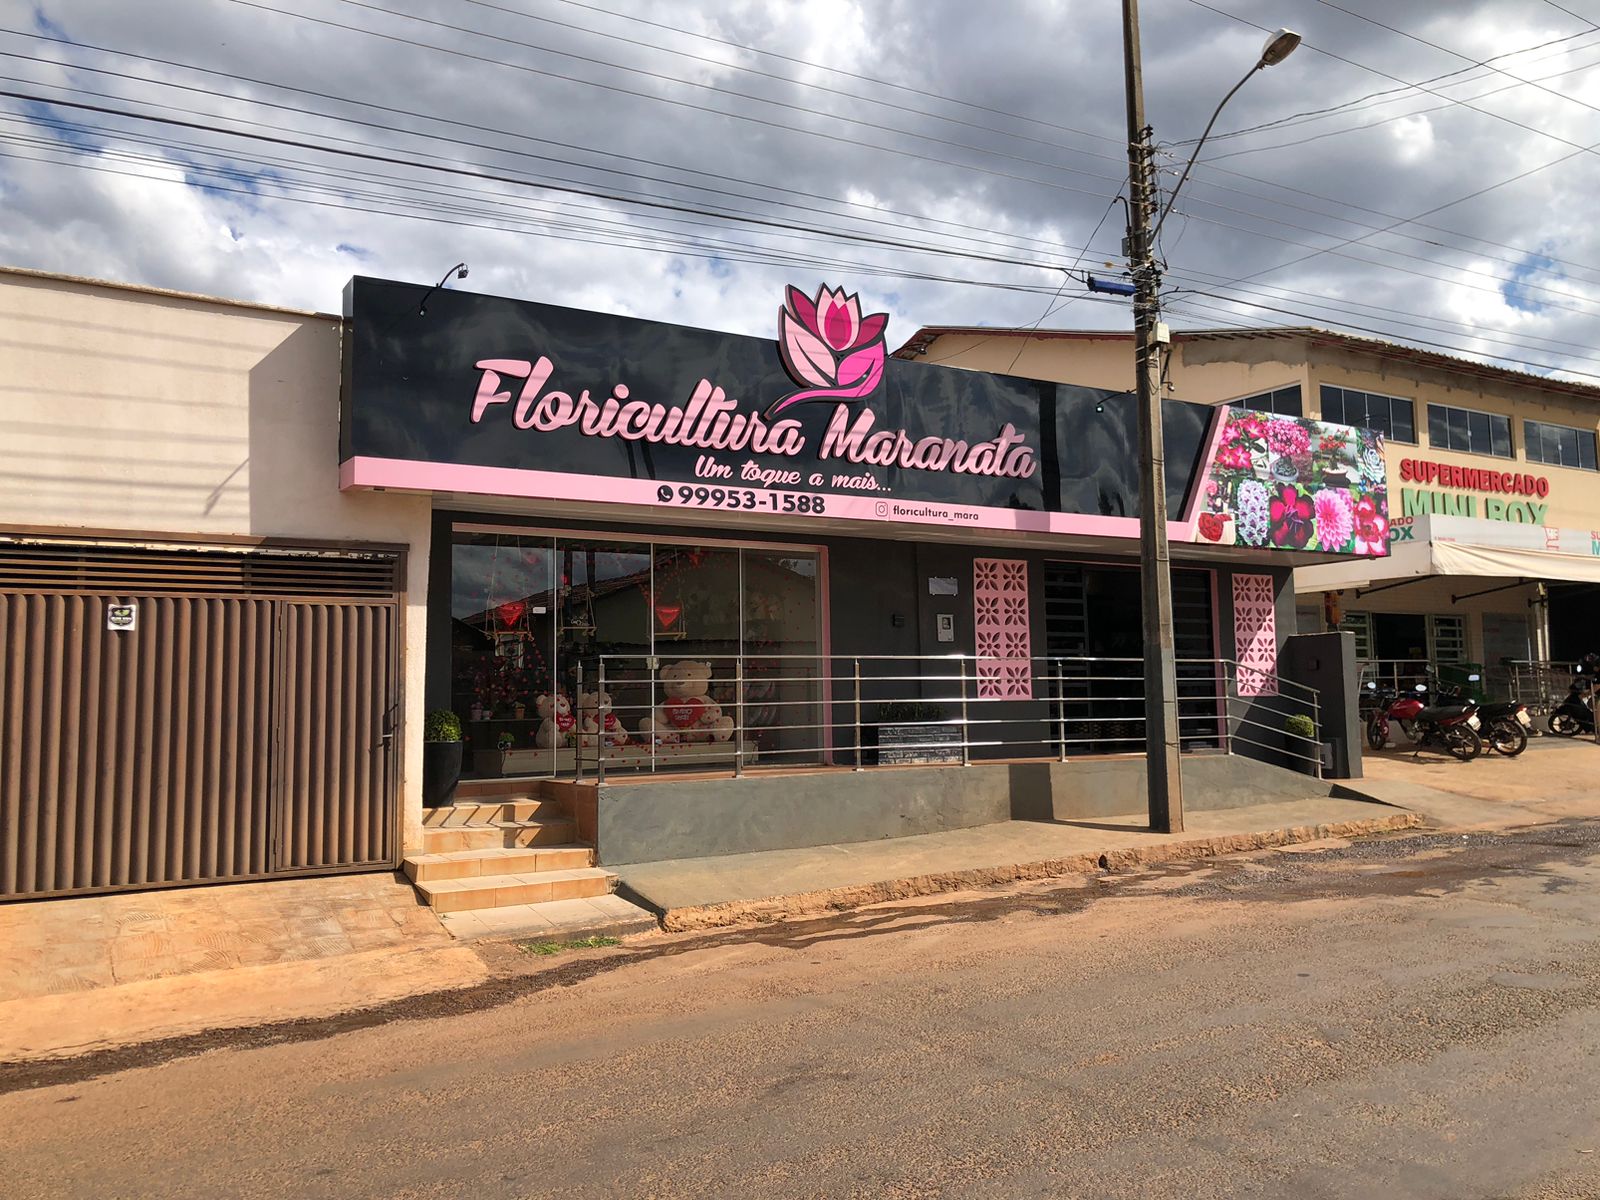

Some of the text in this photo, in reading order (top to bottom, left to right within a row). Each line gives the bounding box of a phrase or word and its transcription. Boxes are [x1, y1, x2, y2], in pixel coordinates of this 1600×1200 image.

[470, 355, 1037, 479] Floricultura Maranata
[694, 454, 892, 492] Um toque a mais...
[1400, 458, 1550, 498] SUPERMERCADO
[678, 485, 826, 514] 99953-1588
[893, 505, 979, 521] floricultura_mara
[1401, 487, 1548, 525] MINI BOX
